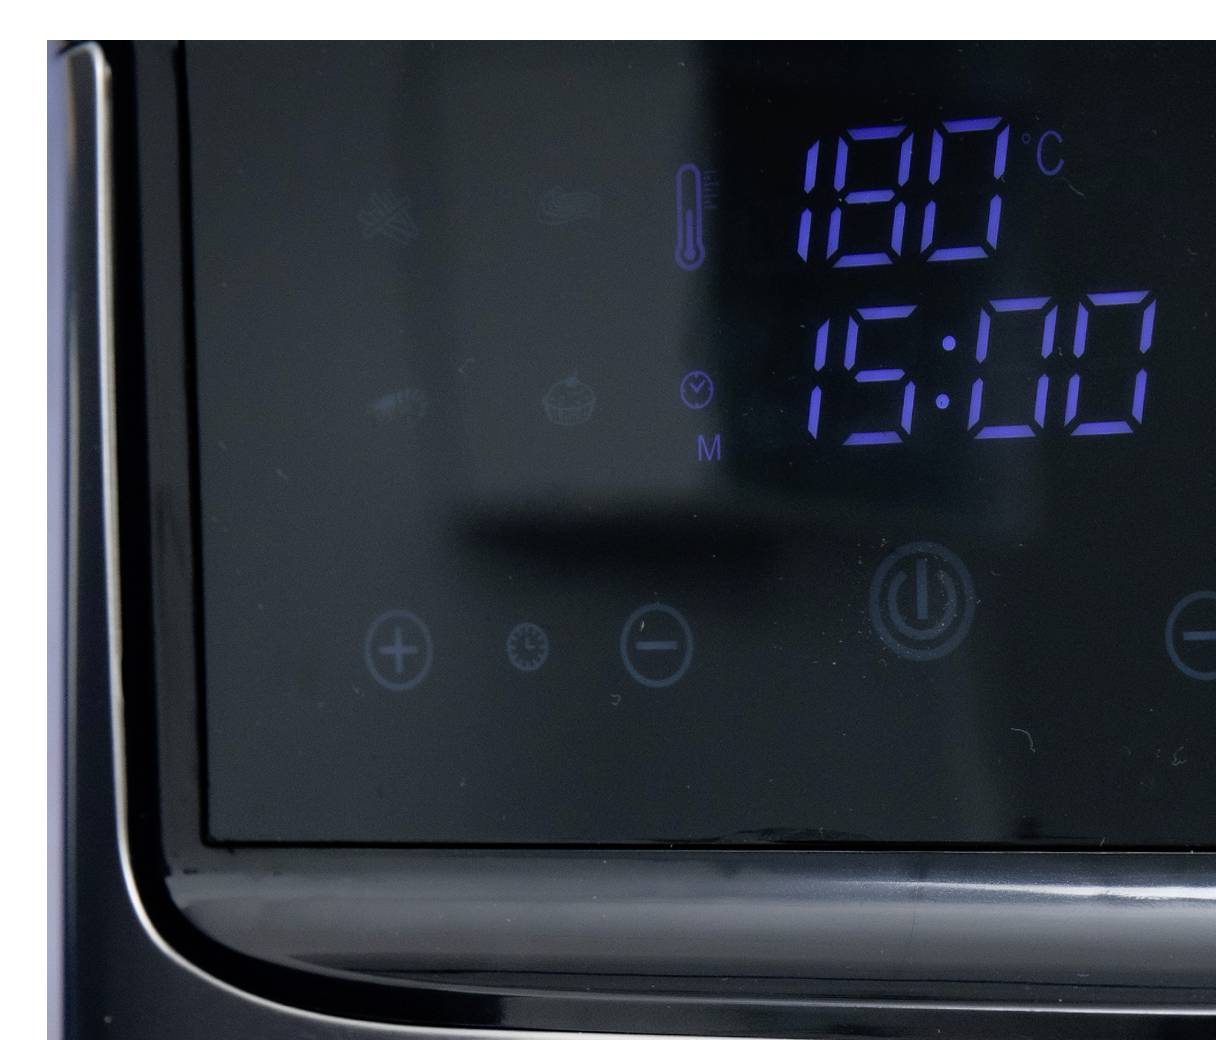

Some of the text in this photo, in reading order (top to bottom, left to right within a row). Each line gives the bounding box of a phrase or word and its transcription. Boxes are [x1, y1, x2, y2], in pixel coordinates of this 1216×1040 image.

[797, 116, 1010, 269] 180
[807, 290, 1157, 446] 15:00
[696, 432, 721, 461] M
